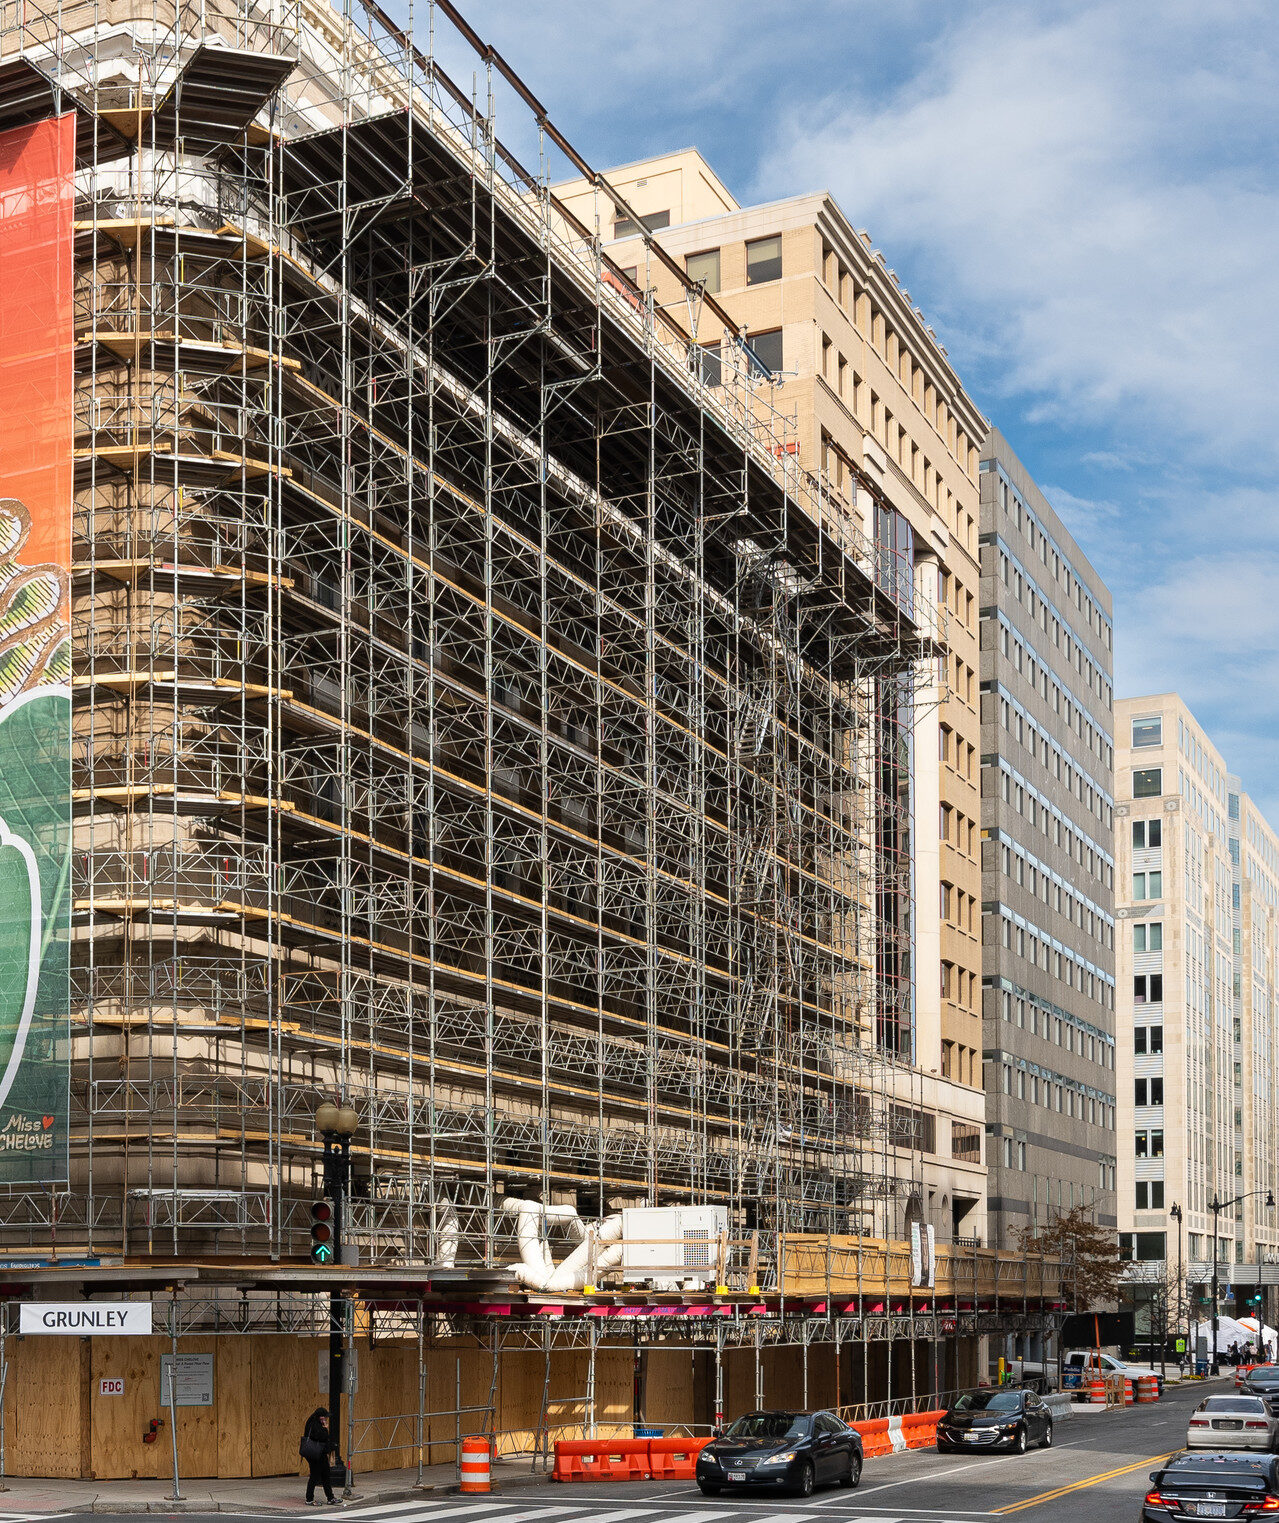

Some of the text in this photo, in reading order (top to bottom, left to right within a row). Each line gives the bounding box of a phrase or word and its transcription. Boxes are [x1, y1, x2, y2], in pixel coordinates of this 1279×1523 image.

[1, 1113, 42, 1132] Miss
[42, 1310, 128, 1328] GRUNLEY
[102, 1381, 121, 1392] FDC
